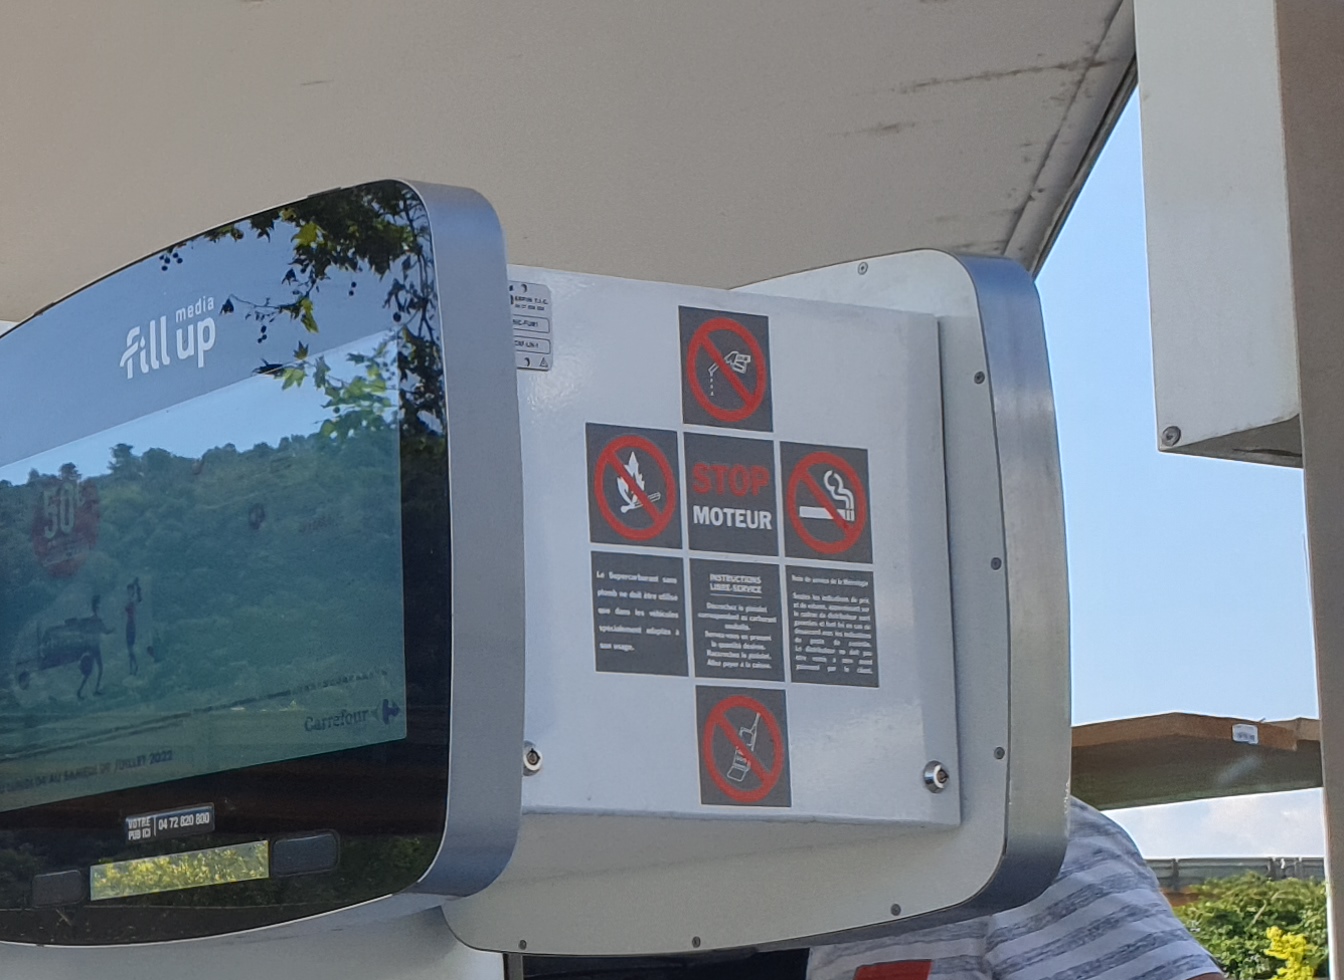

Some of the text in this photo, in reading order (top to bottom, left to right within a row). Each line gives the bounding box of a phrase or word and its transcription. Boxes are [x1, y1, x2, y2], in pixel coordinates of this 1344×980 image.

[175, 295, 215, 323] media
[119, 315, 216, 380] fill up
[692, 462, 771, 498] STOP
[692, 504, 773, 530] MOTEUR
[157, 818, 169, 831] 04
[169, 816, 180, 829] 72
